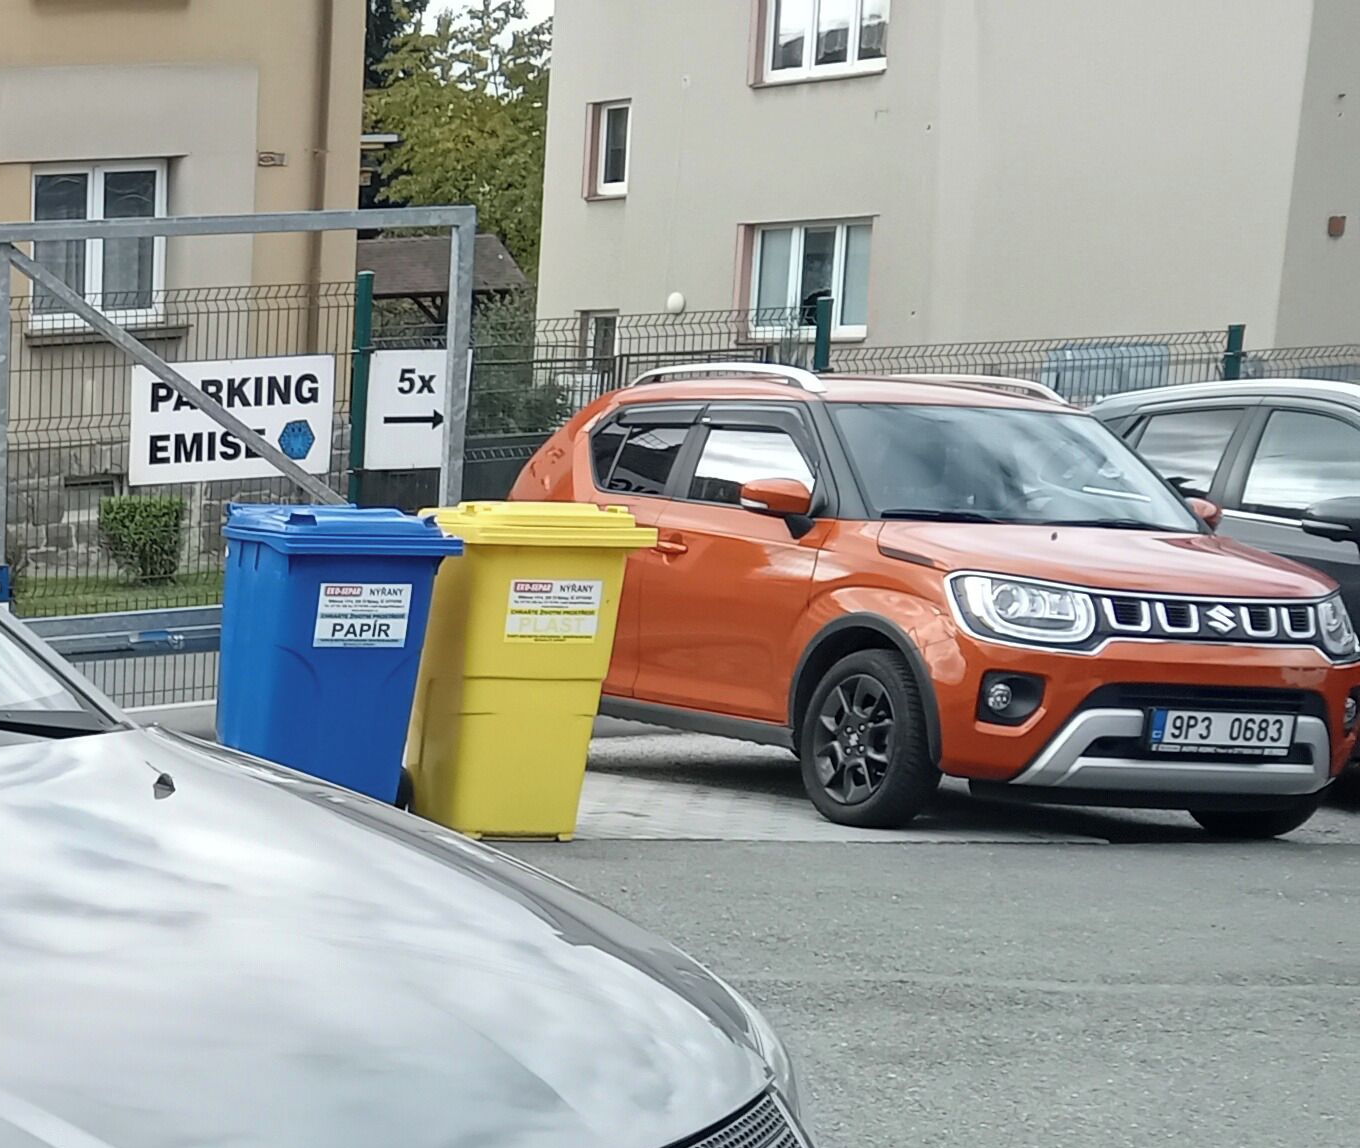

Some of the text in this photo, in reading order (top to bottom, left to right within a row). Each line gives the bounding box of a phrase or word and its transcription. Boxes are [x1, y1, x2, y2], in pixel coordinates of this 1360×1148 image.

[397, 367, 438, 395] 5x
[369, 586, 404, 597] NÝŘANY
[559, 583, 594, 593] NÝŘANY
[331, 620, 391, 638] PAPÍR
[518, 617, 586, 633] PLAST
[1170, 715, 1284, 743] 9P3 0683
